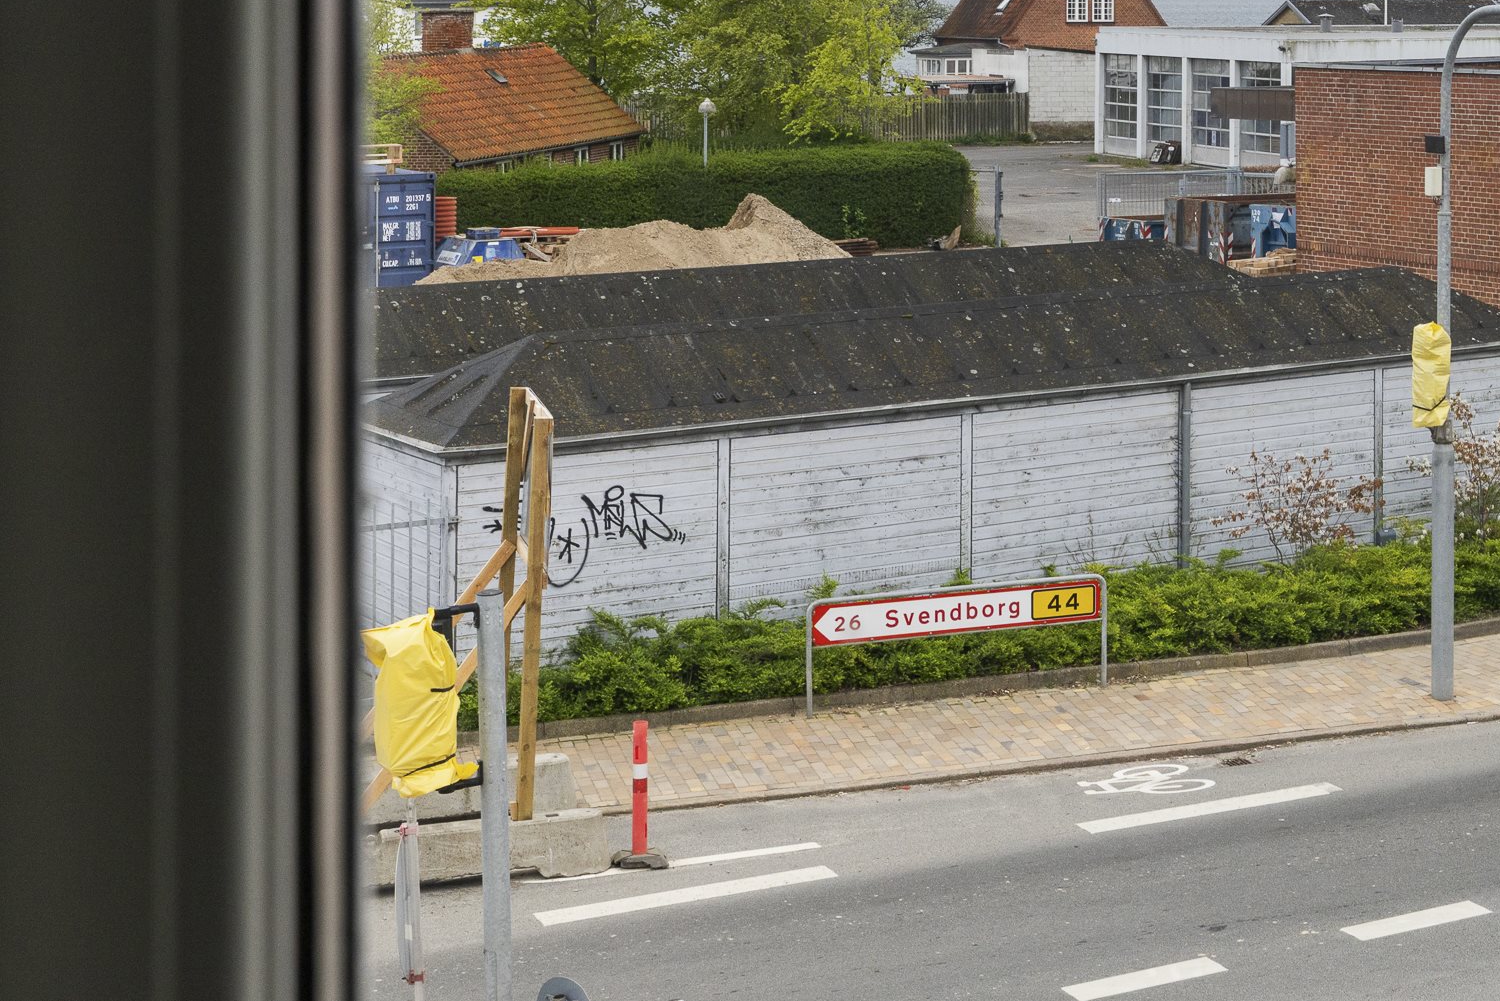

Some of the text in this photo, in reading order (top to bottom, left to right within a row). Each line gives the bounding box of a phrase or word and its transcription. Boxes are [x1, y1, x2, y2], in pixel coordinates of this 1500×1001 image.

[834, 592, 1080, 633] 26 Svendborg 44
